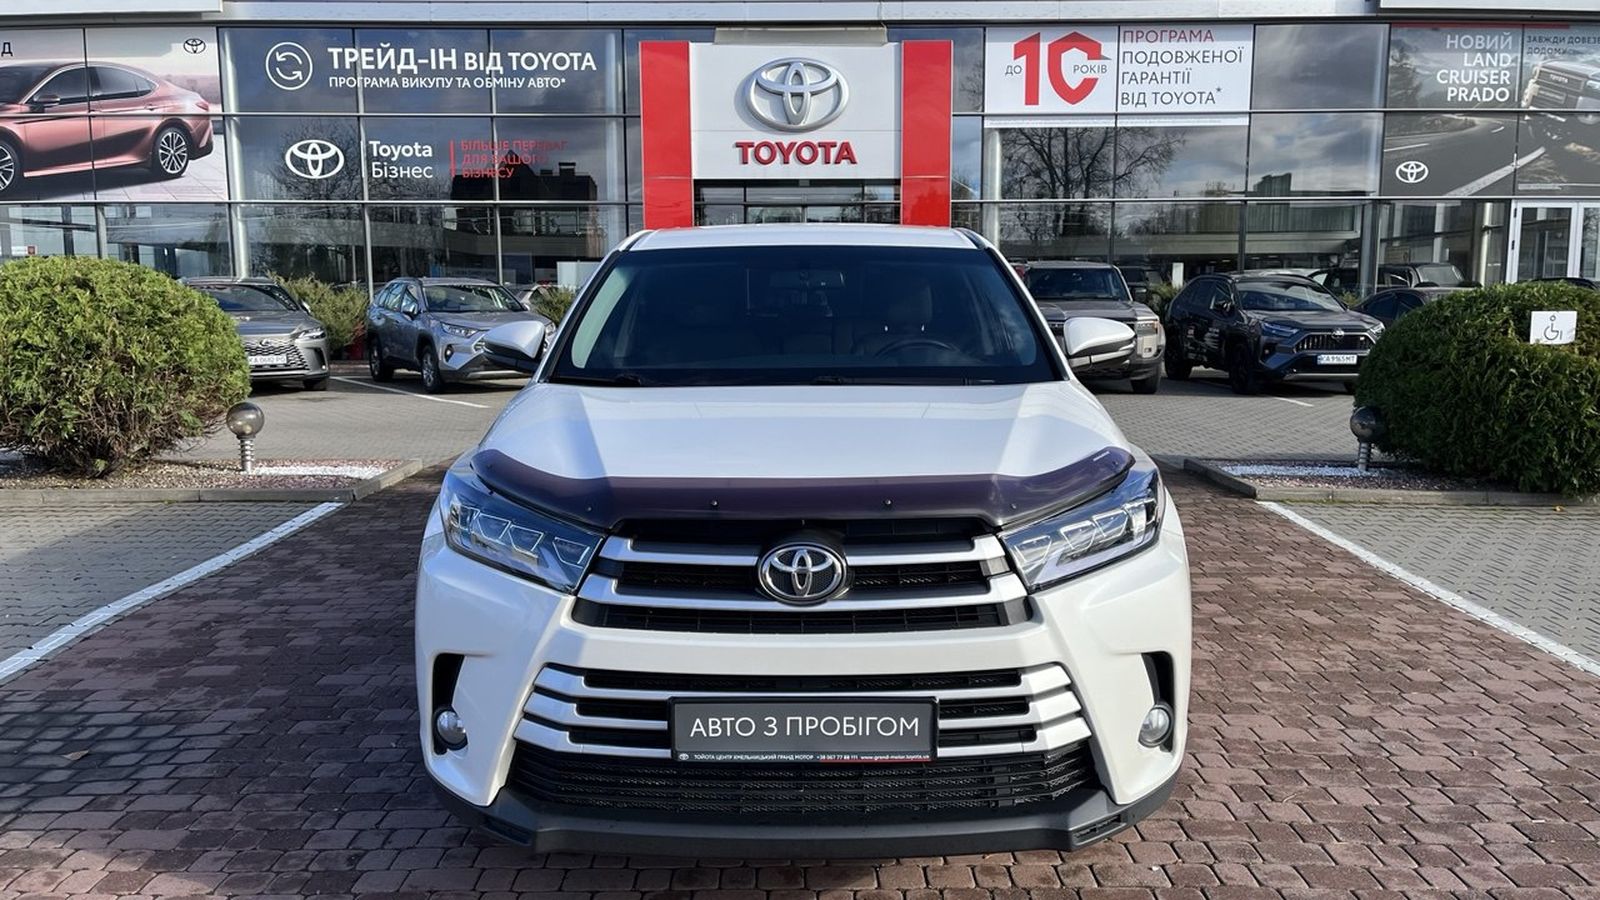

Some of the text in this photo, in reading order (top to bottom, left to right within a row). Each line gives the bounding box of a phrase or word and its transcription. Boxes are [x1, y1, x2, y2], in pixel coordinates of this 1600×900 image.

[1123, 29, 1214, 43] ПРОГРАМА
[1446, 32, 1512, 50] НОВИЙ
[1526, 35, 1566, 44] ЗАВЖДИ
[328, 43, 597, 74] ТРЕЙД-ІН ВІД TOYOTA
[1122, 46, 1244, 66] ПОДОВЖЕНОЇ
[1463, 52, 1512, 67] LAND
[1005, 65, 1022, 76] ДО
[1073, 65, 1107, 74] РОКІВ
[1121, 67, 1192, 84] ГАРАНТІЇ
[1436, 69, 1511, 84] CRUISER
[329, 77, 399, 88] ПРОГРАМА
[402, 77, 453, 88] ВИКУПУ
[456, 77, 471, 88] ТА
[473, 76, 524, 88] ОБМІНУ
[1121, 92, 1147, 108] ВІД
[1447, 87, 1510, 102] PRADO
[368, 140, 433, 161] Toyota
[736, 141, 857, 165] TOYOTA
[372, 162, 433, 178] Бізнес
[690, 716, 919, 737] АВТО З ПРОБІГОМ
